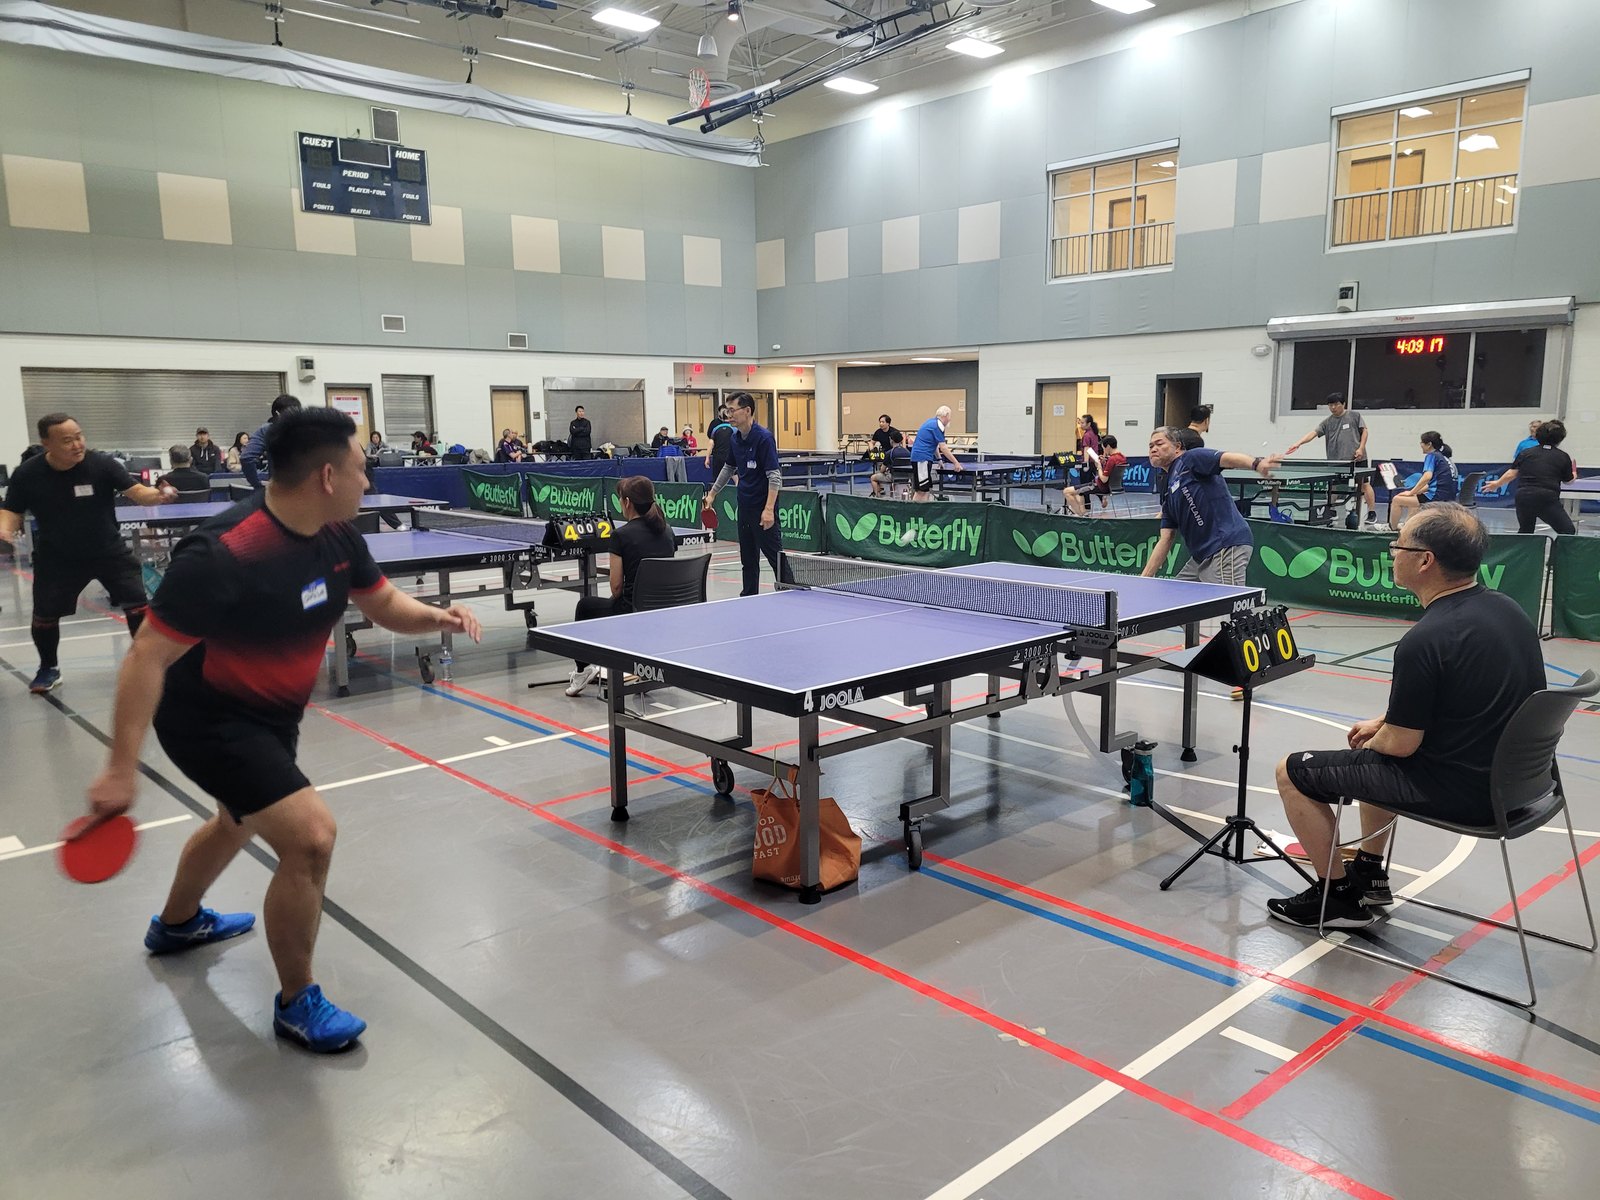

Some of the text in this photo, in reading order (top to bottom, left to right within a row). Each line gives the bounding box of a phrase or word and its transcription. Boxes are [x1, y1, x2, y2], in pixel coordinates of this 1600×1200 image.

[302, 136, 334, 149] GUEST
[395, 150, 421, 161] HOME
[342, 169, 370, 179] PERIOD
[312, 181, 331, 190] FOULS
[348, 186, 387, 196] PLAYER-FOUL
[1397, 337, 1444, 354] 4:09 17
[484, 484, 517, 507] Butterfly
[549, 485, 595, 511] Butterfly
[654, 494, 698, 523] tterfly
[1181, 486, 1204, 527] MARYLAND
[120, 522, 148, 530] JOOLA
[778, 504, 811, 533] erfly
[564, 521, 611, 541] 4 0 0 2
[683, 532, 714, 546] JOOLA 2
[878, 514, 982, 556] Butterfly
[1060, 532, 1181, 574] Butterfy
[1233, 597, 1256, 613] JOOLA
[1328, 588, 1421, 607] www.butterfly
[1084, 631, 1110, 640] JOOLA
[1024, 642, 1054, 659] 3000 SC
[1243, 639, 1260, 672] 0
[1262, 633, 1271, 650] 0
[1276, 628, 1293, 660] 0
[633, 661, 665, 683] JOOLA
[803, 686, 863, 713] 4 JOOLA
[754, 847, 780, 859] FAST
